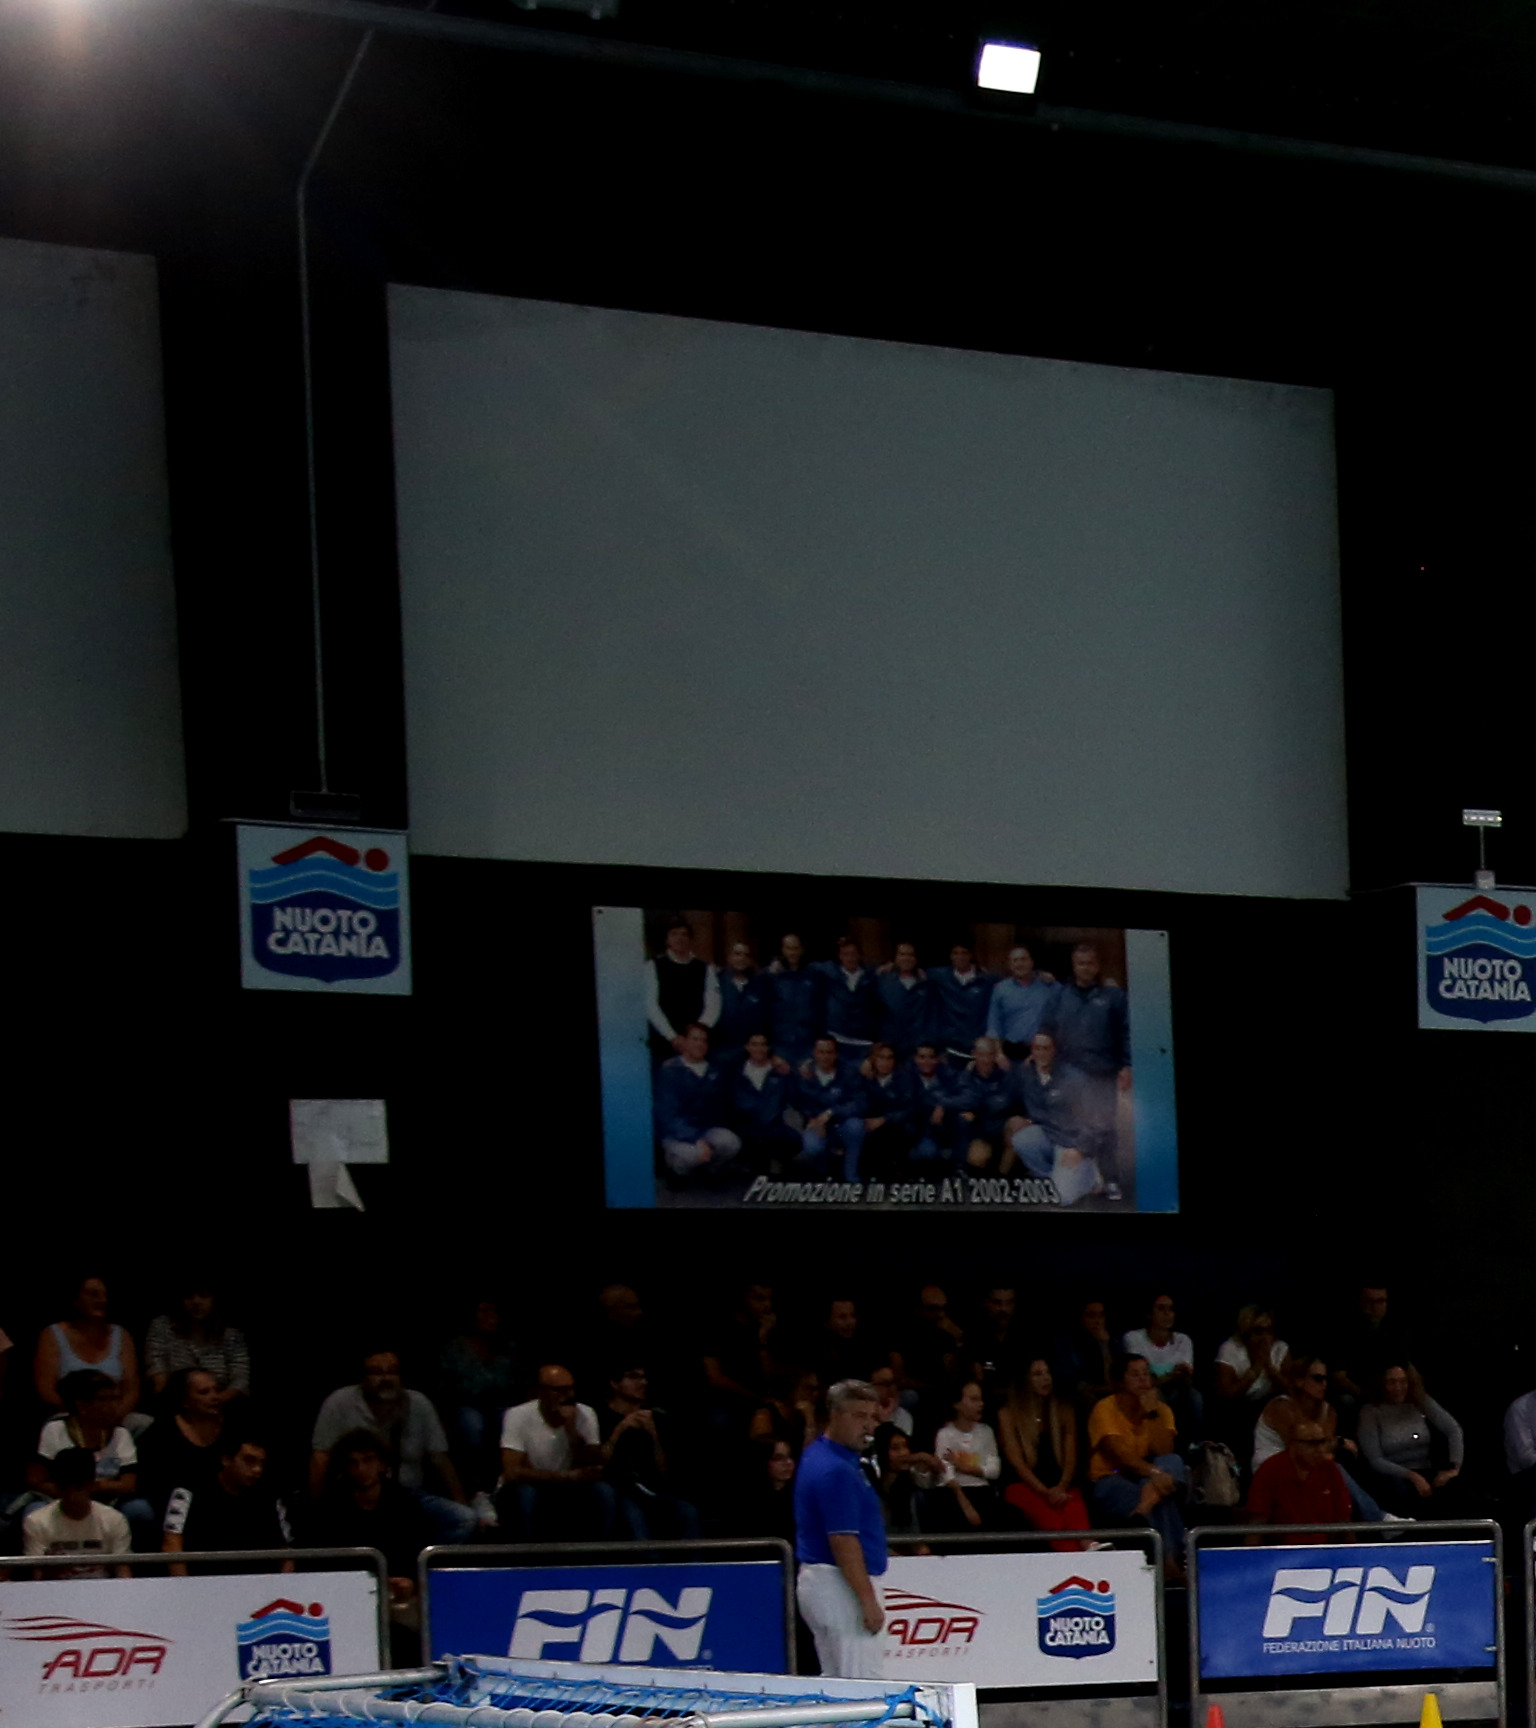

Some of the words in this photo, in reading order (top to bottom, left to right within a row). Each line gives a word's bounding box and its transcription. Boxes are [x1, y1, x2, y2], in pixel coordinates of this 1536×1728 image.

[272, 905, 378, 935] NUOTO
[266, 931, 391, 959] CATANIA
[1443, 957, 1523, 980] NUOTO
[1438, 978, 1532, 1002] CATANIA
[743, 1174, 865, 1203] Promozione
[867, 1176, 886, 1203] in
[888, 1177, 936, 1203] serie
[938, 1178, 963, 1204] A1
[1262, 1565, 1436, 1639] FIN
[508, 1586, 713, 1663] FIN
[887, 1616, 978, 1645] ADR
[1049, 1615, 1106, 1632] NUOTO
[1044, 1629, 1111, 1647] CATANIA
[1262, 1640, 1340, 1654] FEDERAZIONE
[1343, 1638, 1394, 1651] ITALIANA
[1396, 1637, 1437, 1649] NUOTO
[251, 1641, 319, 1659] NUOTO
[883, 1646, 968, 1658] RASPORTI
[42, 1646, 167, 1680] ADR
[247, 1656, 326, 1679] CATANIA
[39, 1678, 156, 1694] TRASPORTI
